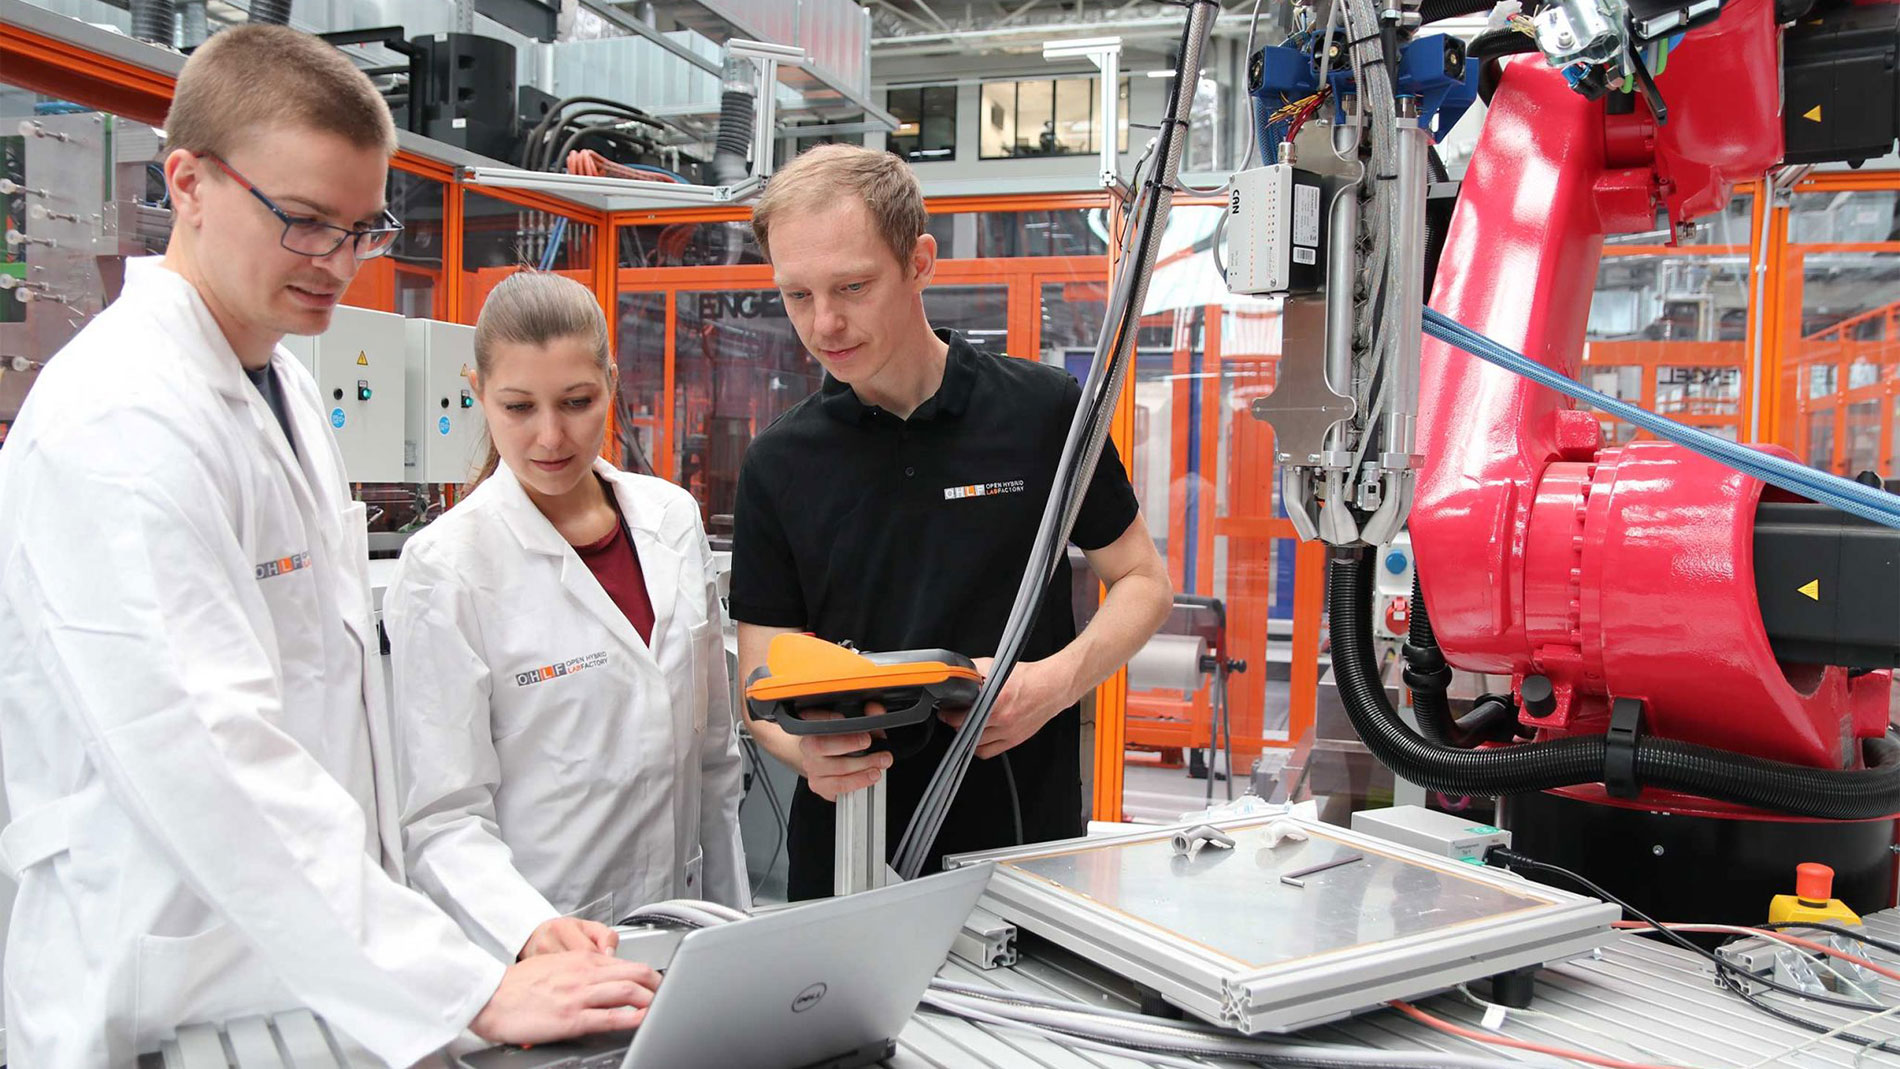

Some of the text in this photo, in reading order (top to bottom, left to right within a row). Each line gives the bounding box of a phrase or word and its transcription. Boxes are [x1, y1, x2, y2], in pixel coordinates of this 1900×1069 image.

[1232, 189, 1240, 214] CAN
[944, 484, 985, 500] OHLF
[986, 482, 1002, 490] OPEN
[986, 486, 1024, 496] LABFACTORY
[256, 554, 303, 580] OHLF
[566, 651, 607, 667] OPEN HYBRID
[567, 658, 608, 674] LABFACTORY
[515, 662, 567, 687] OHLF
